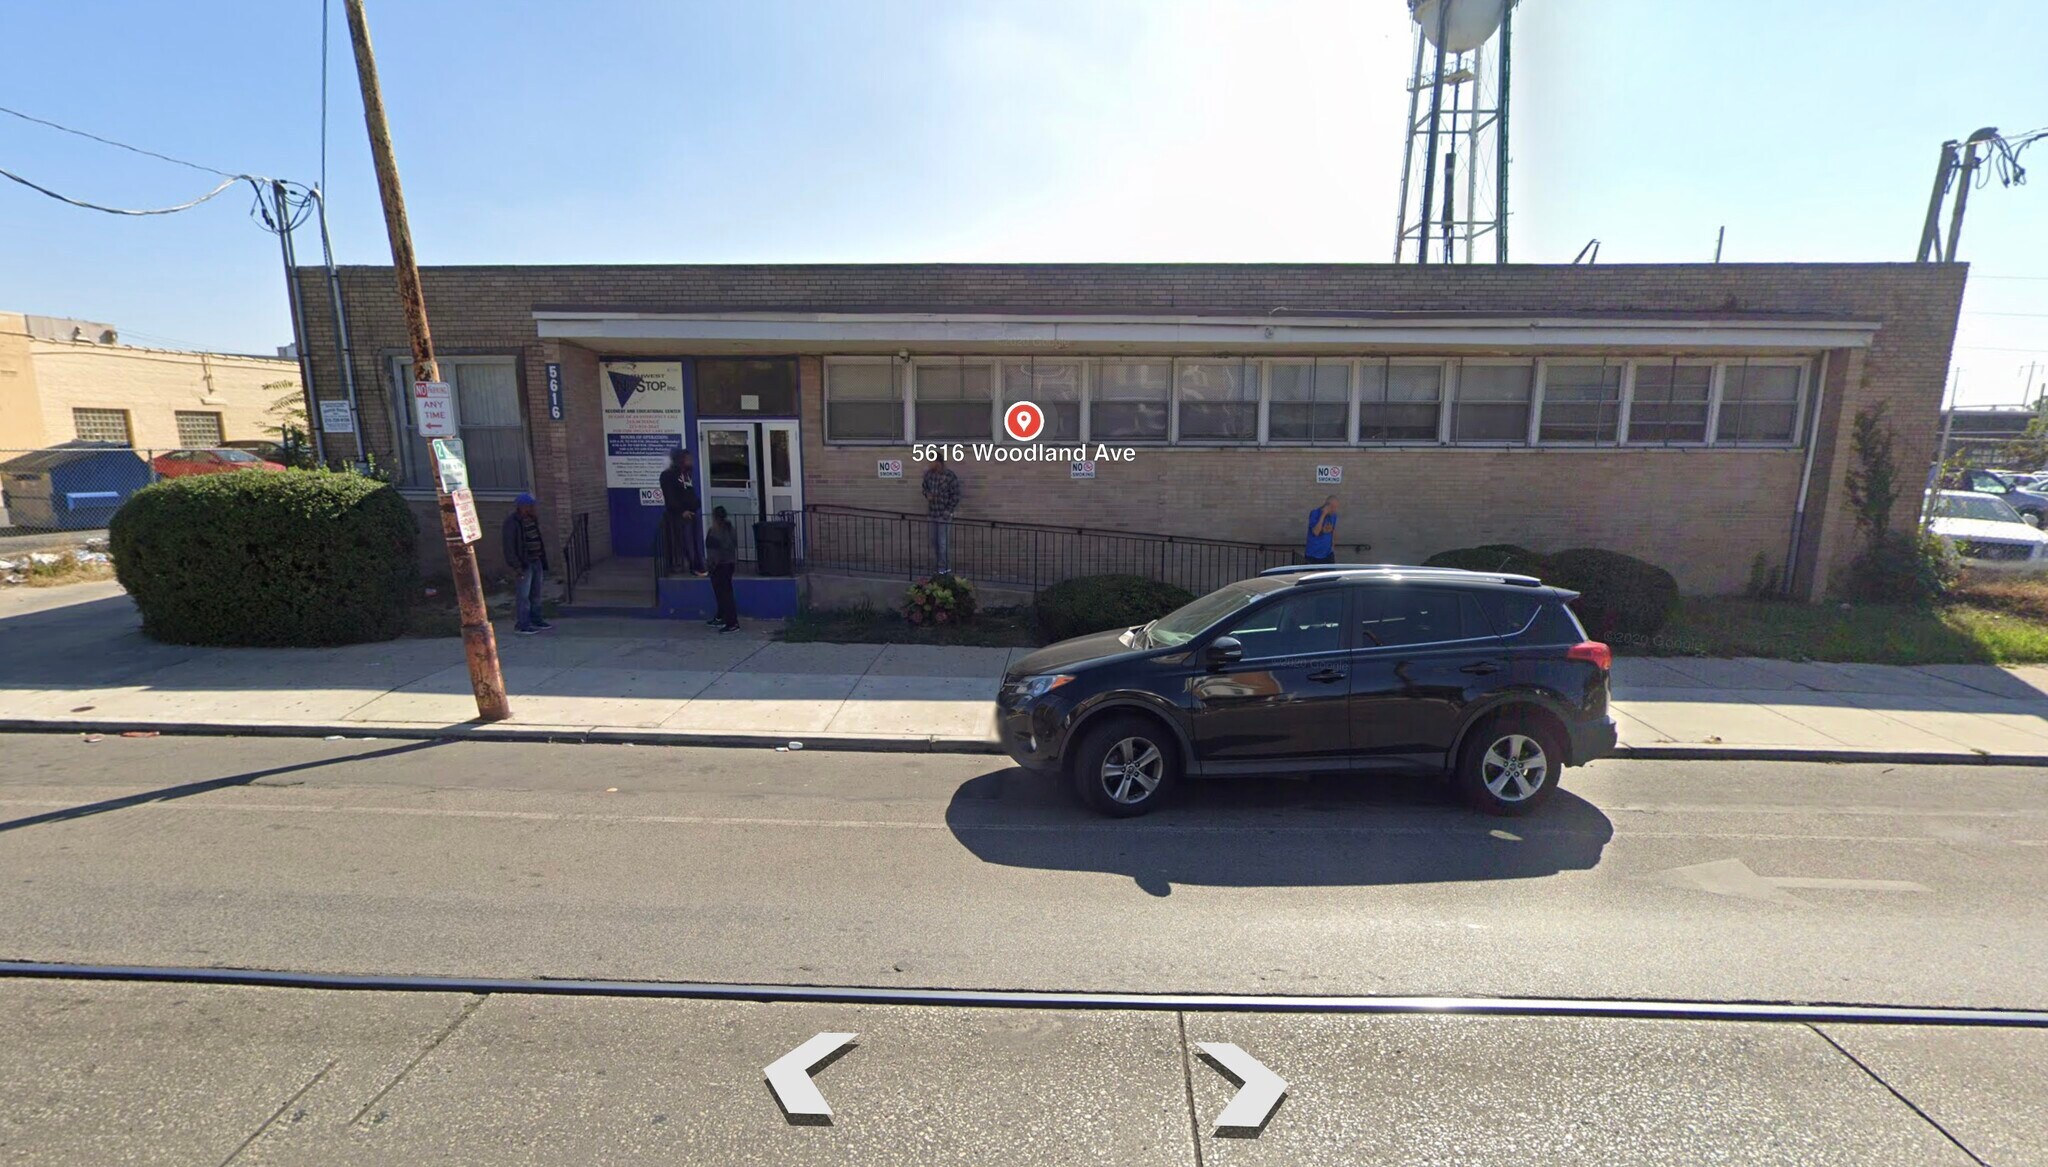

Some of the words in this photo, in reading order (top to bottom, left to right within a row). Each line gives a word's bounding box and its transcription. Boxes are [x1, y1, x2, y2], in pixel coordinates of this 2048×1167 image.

[416, 384, 427, 396] NO
[549, 365, 560, 419] 5616
[425, 411, 446, 419] TIME
[436, 443, 444, 457] 2
[879, 462, 889, 471] NO
[1072, 463, 1083, 471] NO
[1318, 467, 1329, 476] NO
[641, 490, 652, 499] NO
